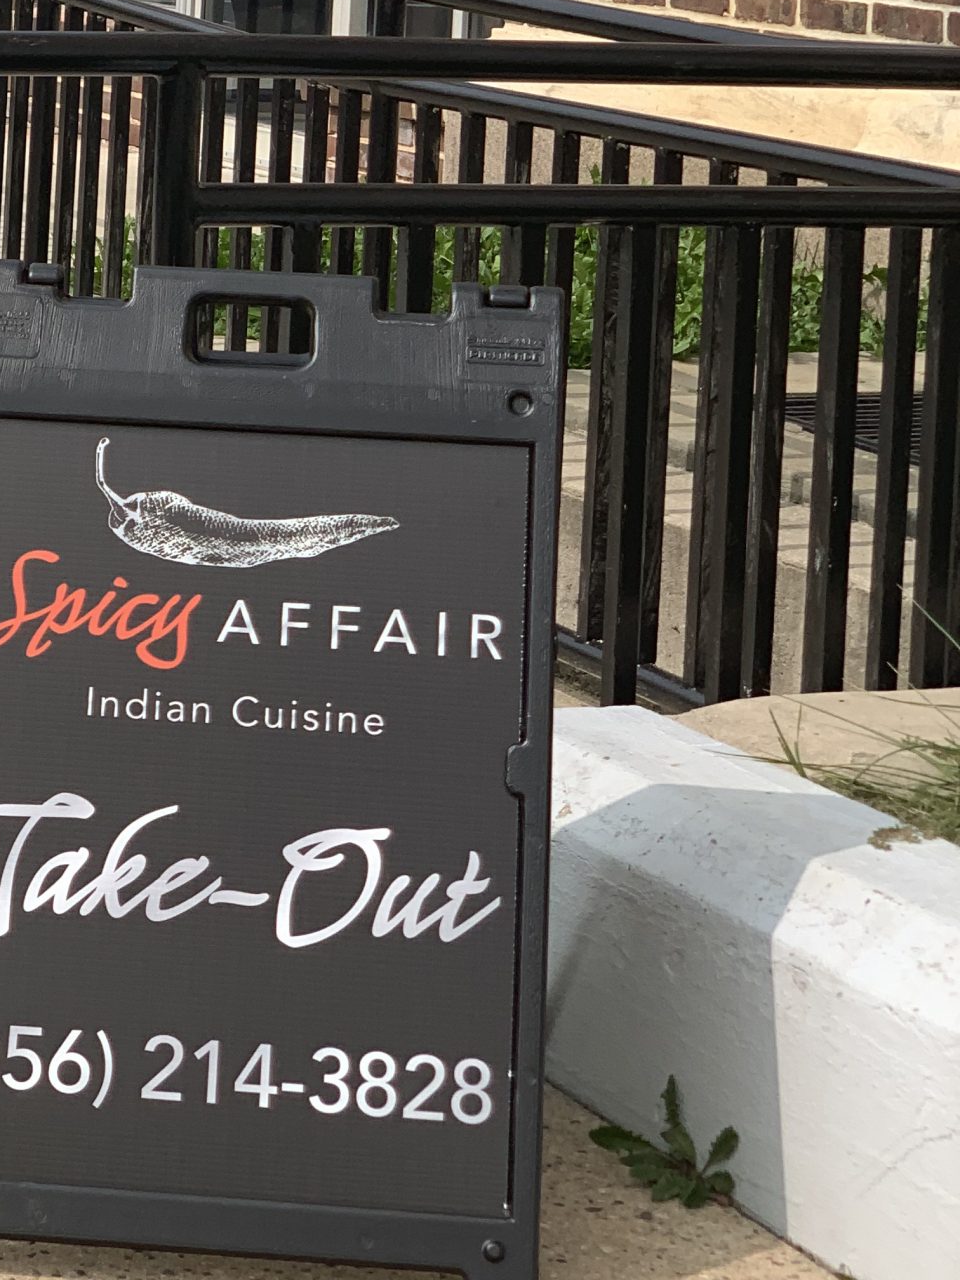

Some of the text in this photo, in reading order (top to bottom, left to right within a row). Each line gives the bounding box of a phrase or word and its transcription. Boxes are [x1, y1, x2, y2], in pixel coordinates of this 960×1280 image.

[216, 599, 503, 660] AFFAIR
[86, 686, 385, 736] Indian Cuisine
[141, 1034, 493, 1125] 214-3828
